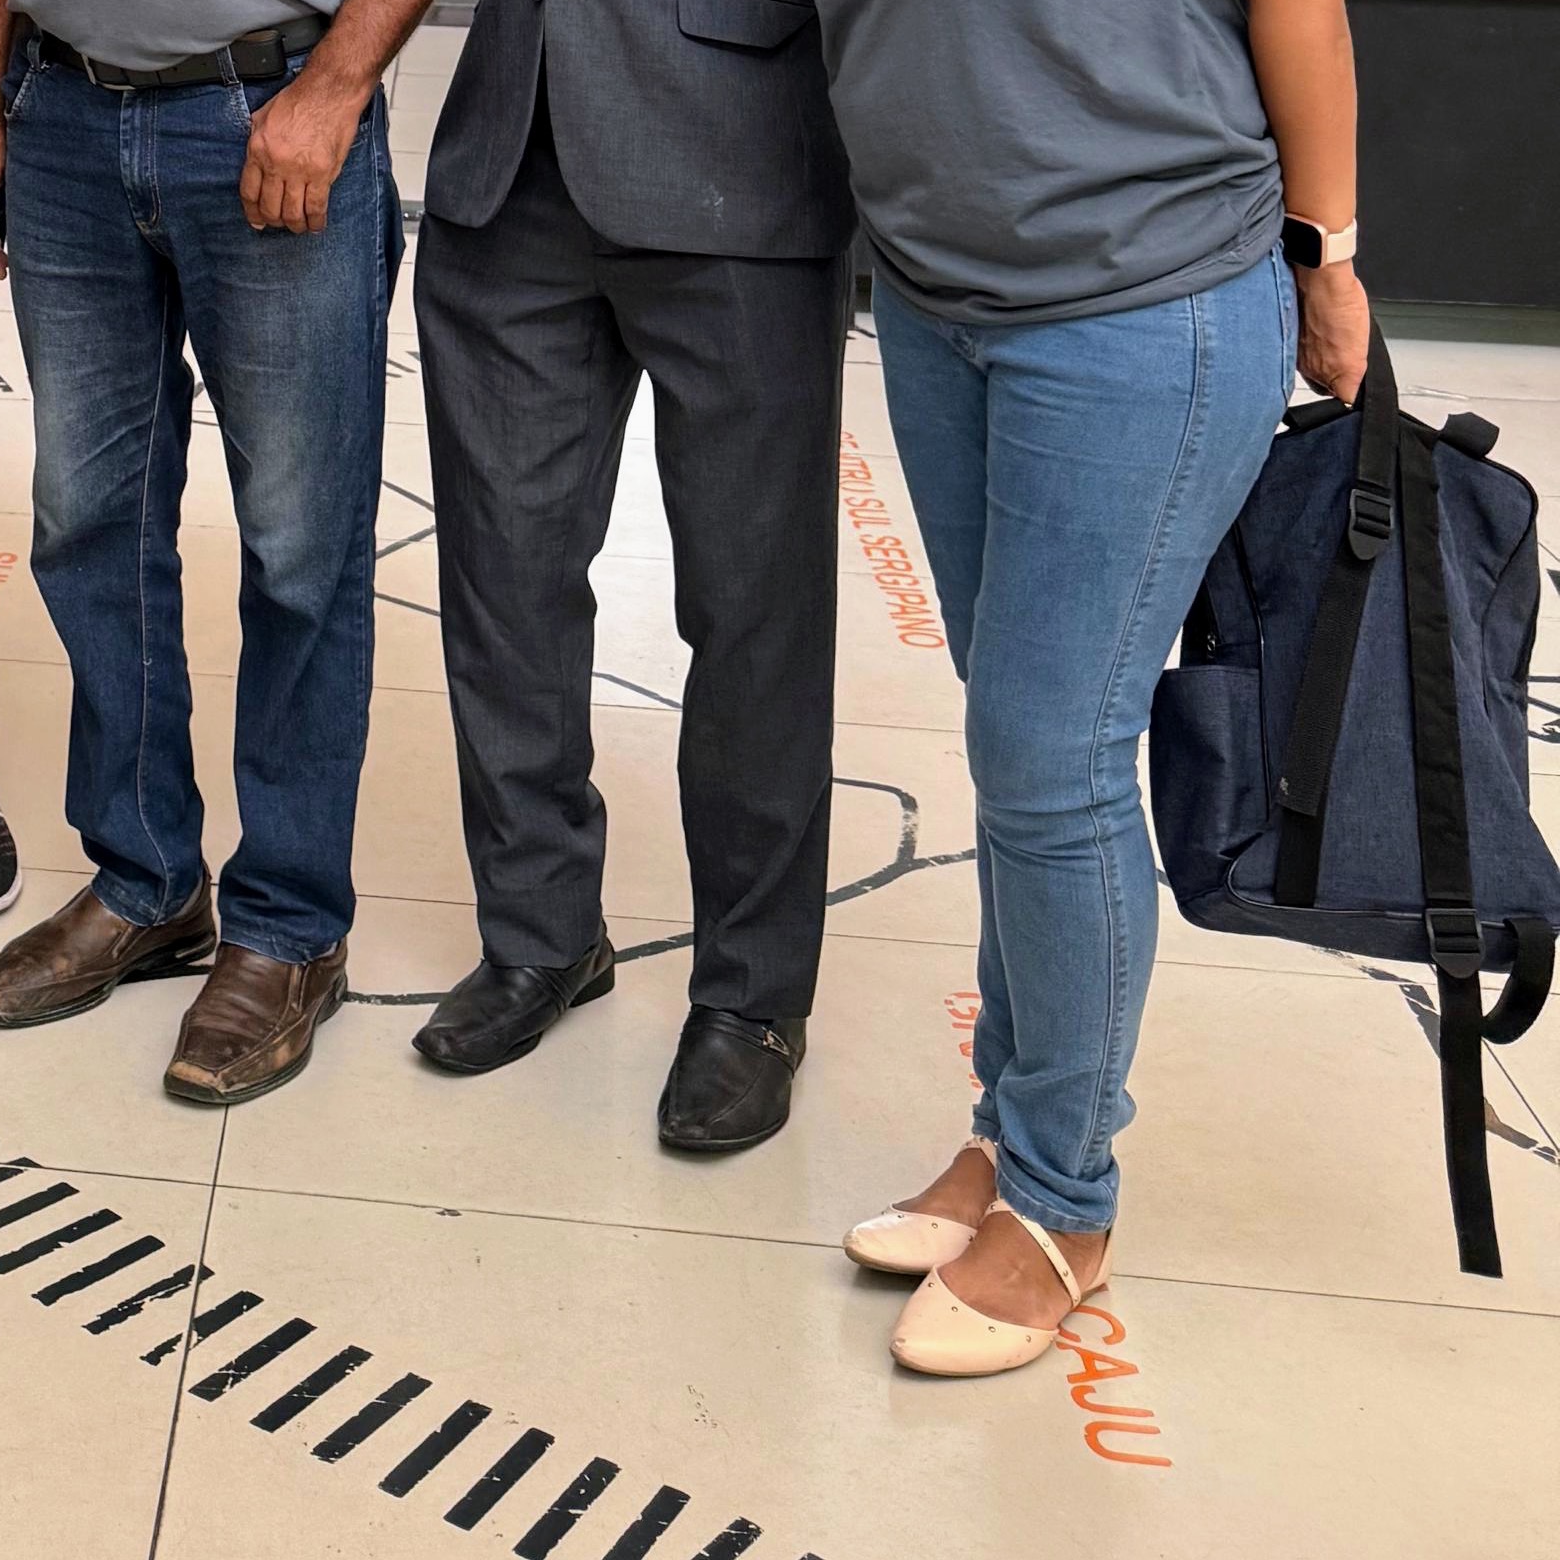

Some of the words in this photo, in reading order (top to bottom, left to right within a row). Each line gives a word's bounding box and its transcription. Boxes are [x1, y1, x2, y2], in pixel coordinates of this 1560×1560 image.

[843, 496, 892, 529] SUL
[859, 533, 946, 650] SERGIPANO
[1055, 1283, 1173, 1468] CAJU
